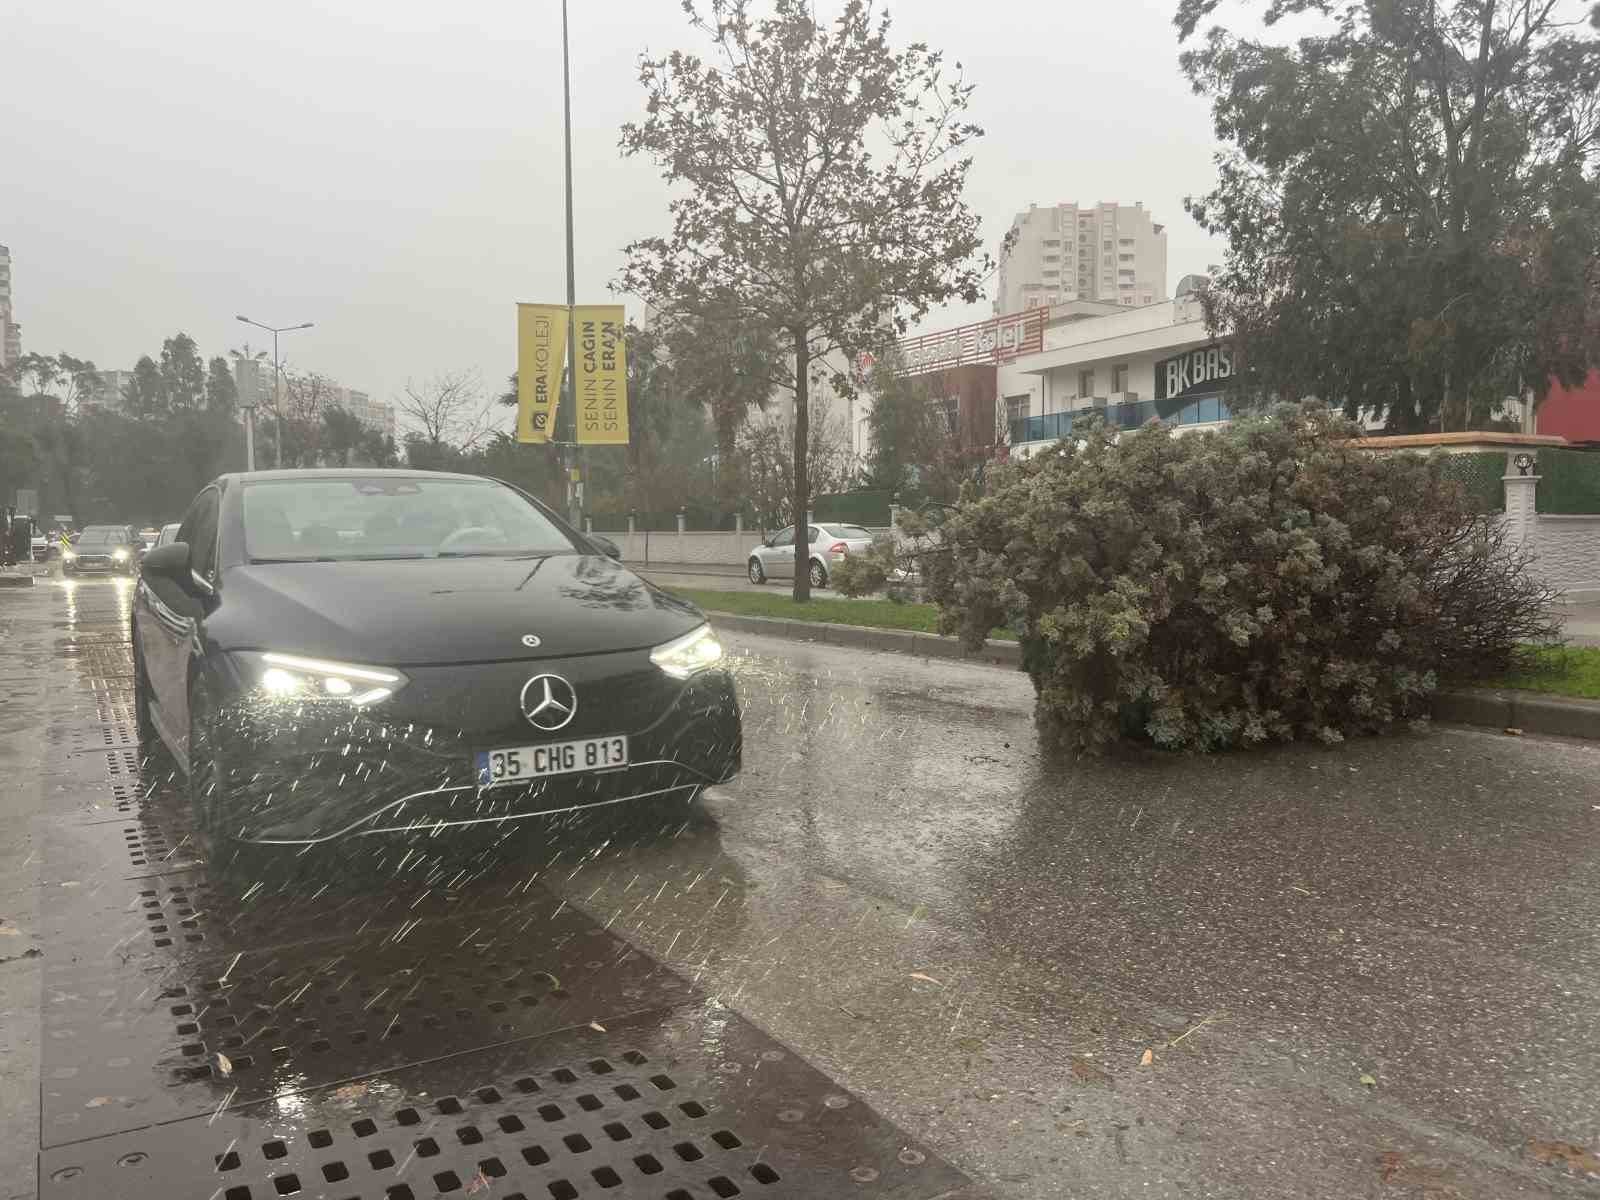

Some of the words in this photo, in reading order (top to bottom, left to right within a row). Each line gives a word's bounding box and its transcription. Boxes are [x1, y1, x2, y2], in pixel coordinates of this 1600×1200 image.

[1192, 347, 1237, 385] BAS
[492, 751, 521, 778] 35
[534, 744, 575, 773] CHG
[585, 738, 624, 766] 813
